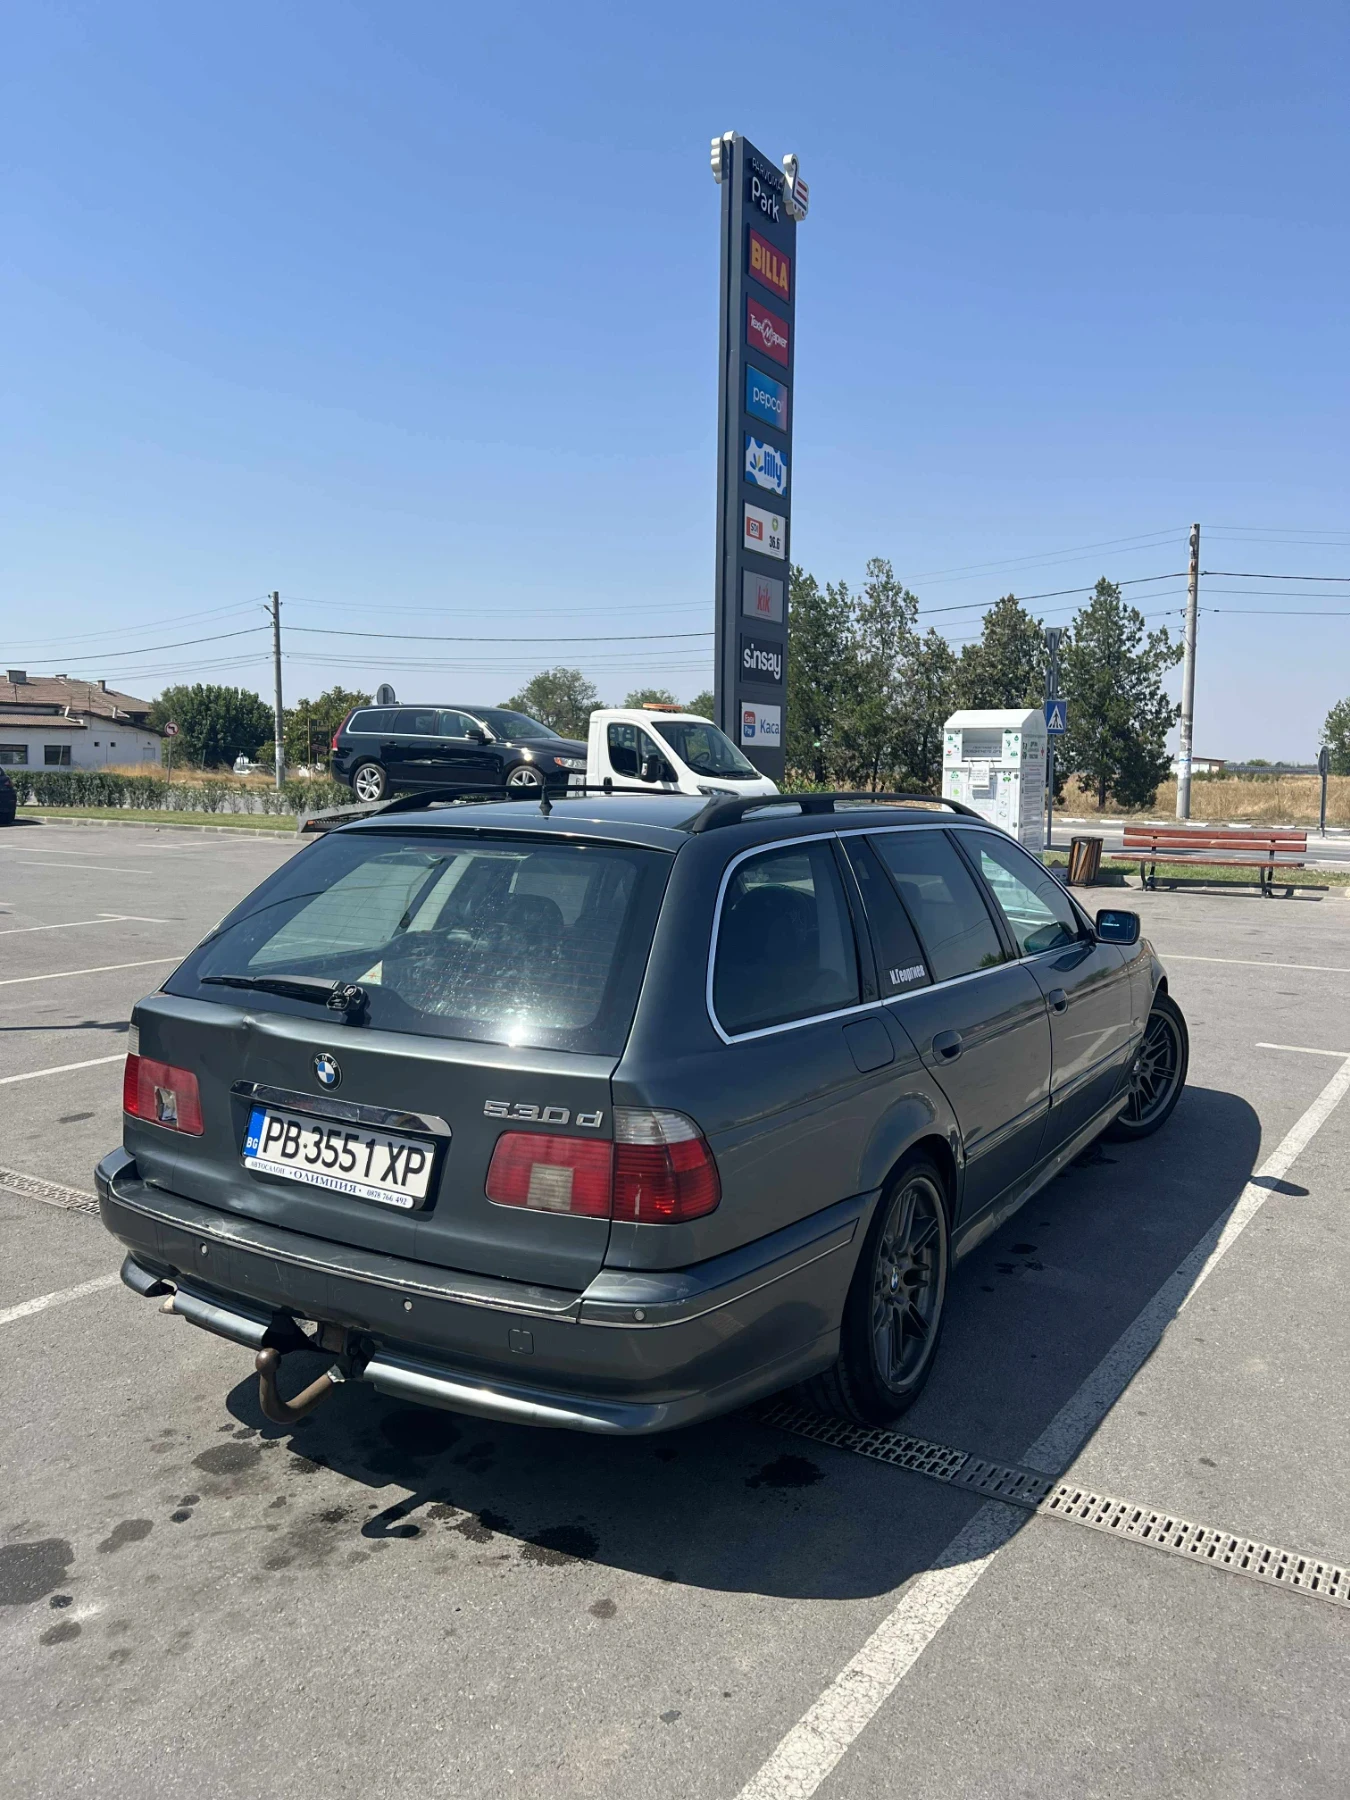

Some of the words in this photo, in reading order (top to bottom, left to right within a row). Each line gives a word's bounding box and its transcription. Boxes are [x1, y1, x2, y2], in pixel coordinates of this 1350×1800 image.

[751, 176, 780, 223] Park
[751, 238, 788, 291] BILLA
[752, 386, 782, 413] pepco
[763, 450, 782, 488] lilly
[768, 535, 781, 550] 36.6
[757, 583, 771, 613] kik
[743, 643, 782, 680] sinsay
[744, 714, 755, 724] Easy
[744, 725, 753, 736] Pay
[314, 1055, 338, 1068] BMW
[245, 1136, 259, 1150] BG
[250, 1161, 285, 1175] АВТОСАЛОН
[293, 1170, 357, 1194] ОЛИМПИЯ
